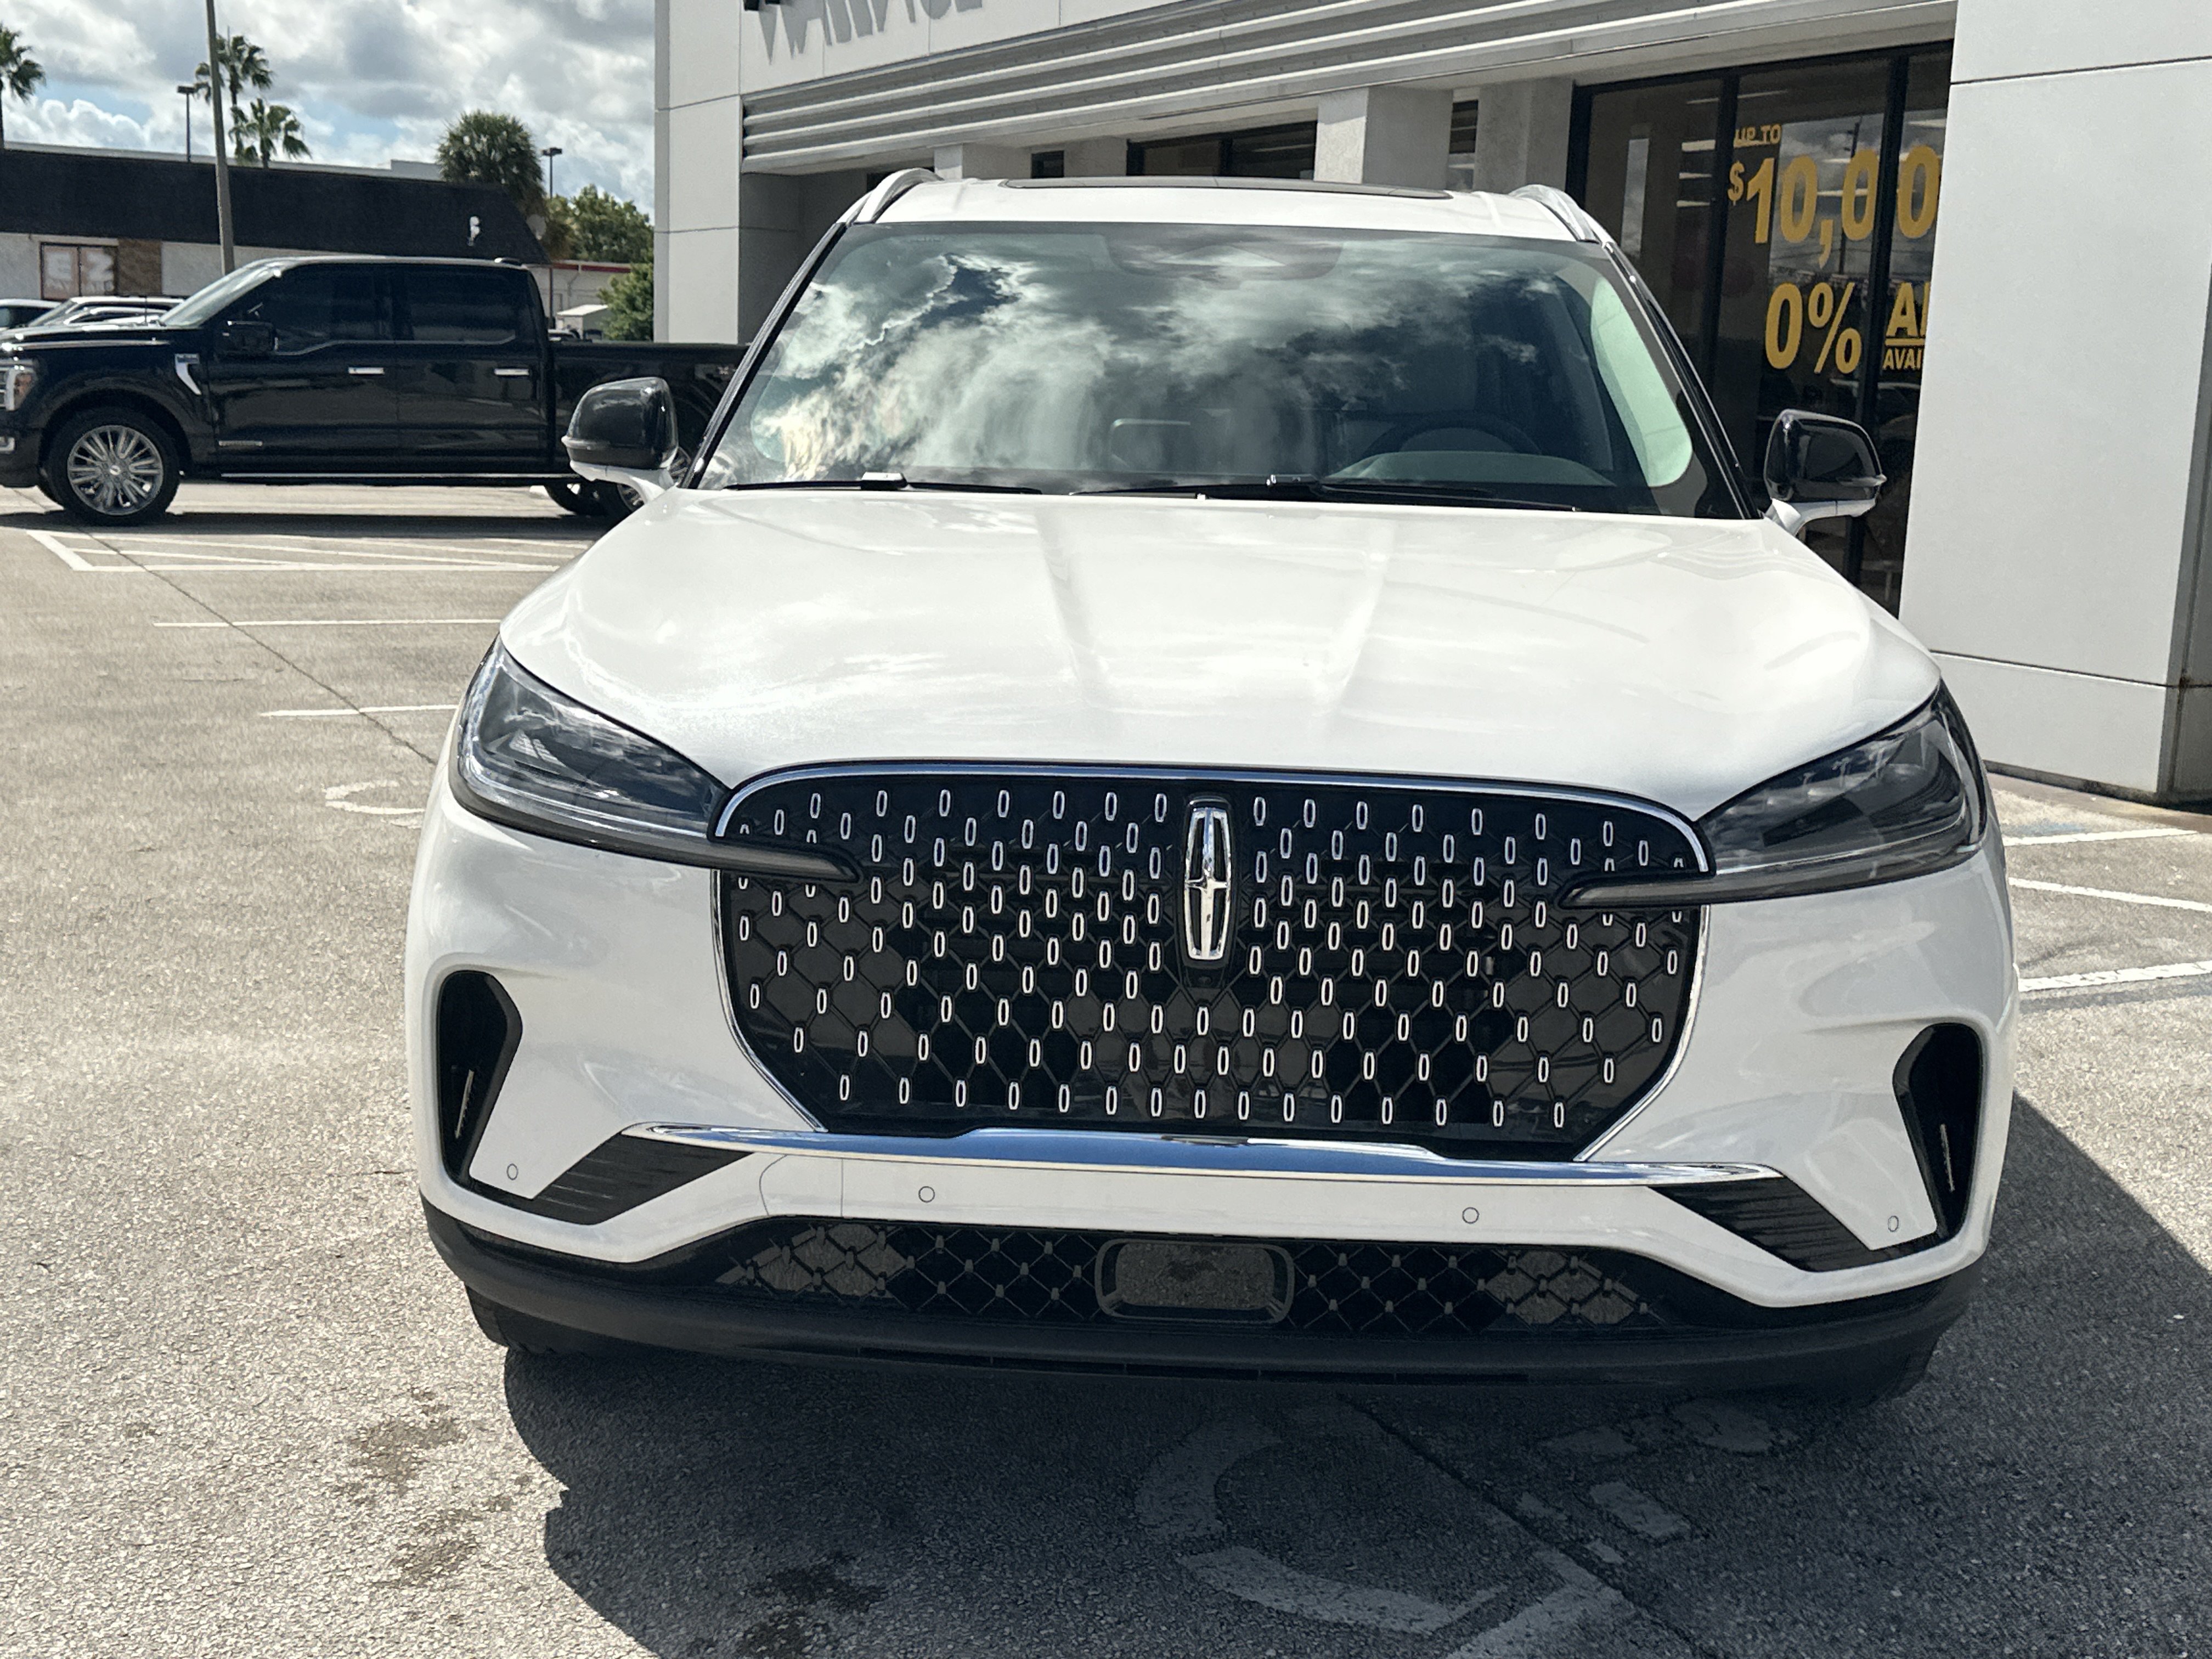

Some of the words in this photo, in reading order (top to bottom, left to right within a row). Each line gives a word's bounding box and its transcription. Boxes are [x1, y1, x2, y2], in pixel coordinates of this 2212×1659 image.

[1734, 127, 1756, 144] UP
[1760, 124, 1782, 144] TO
[1765, 282, 1862, 374] 0%
